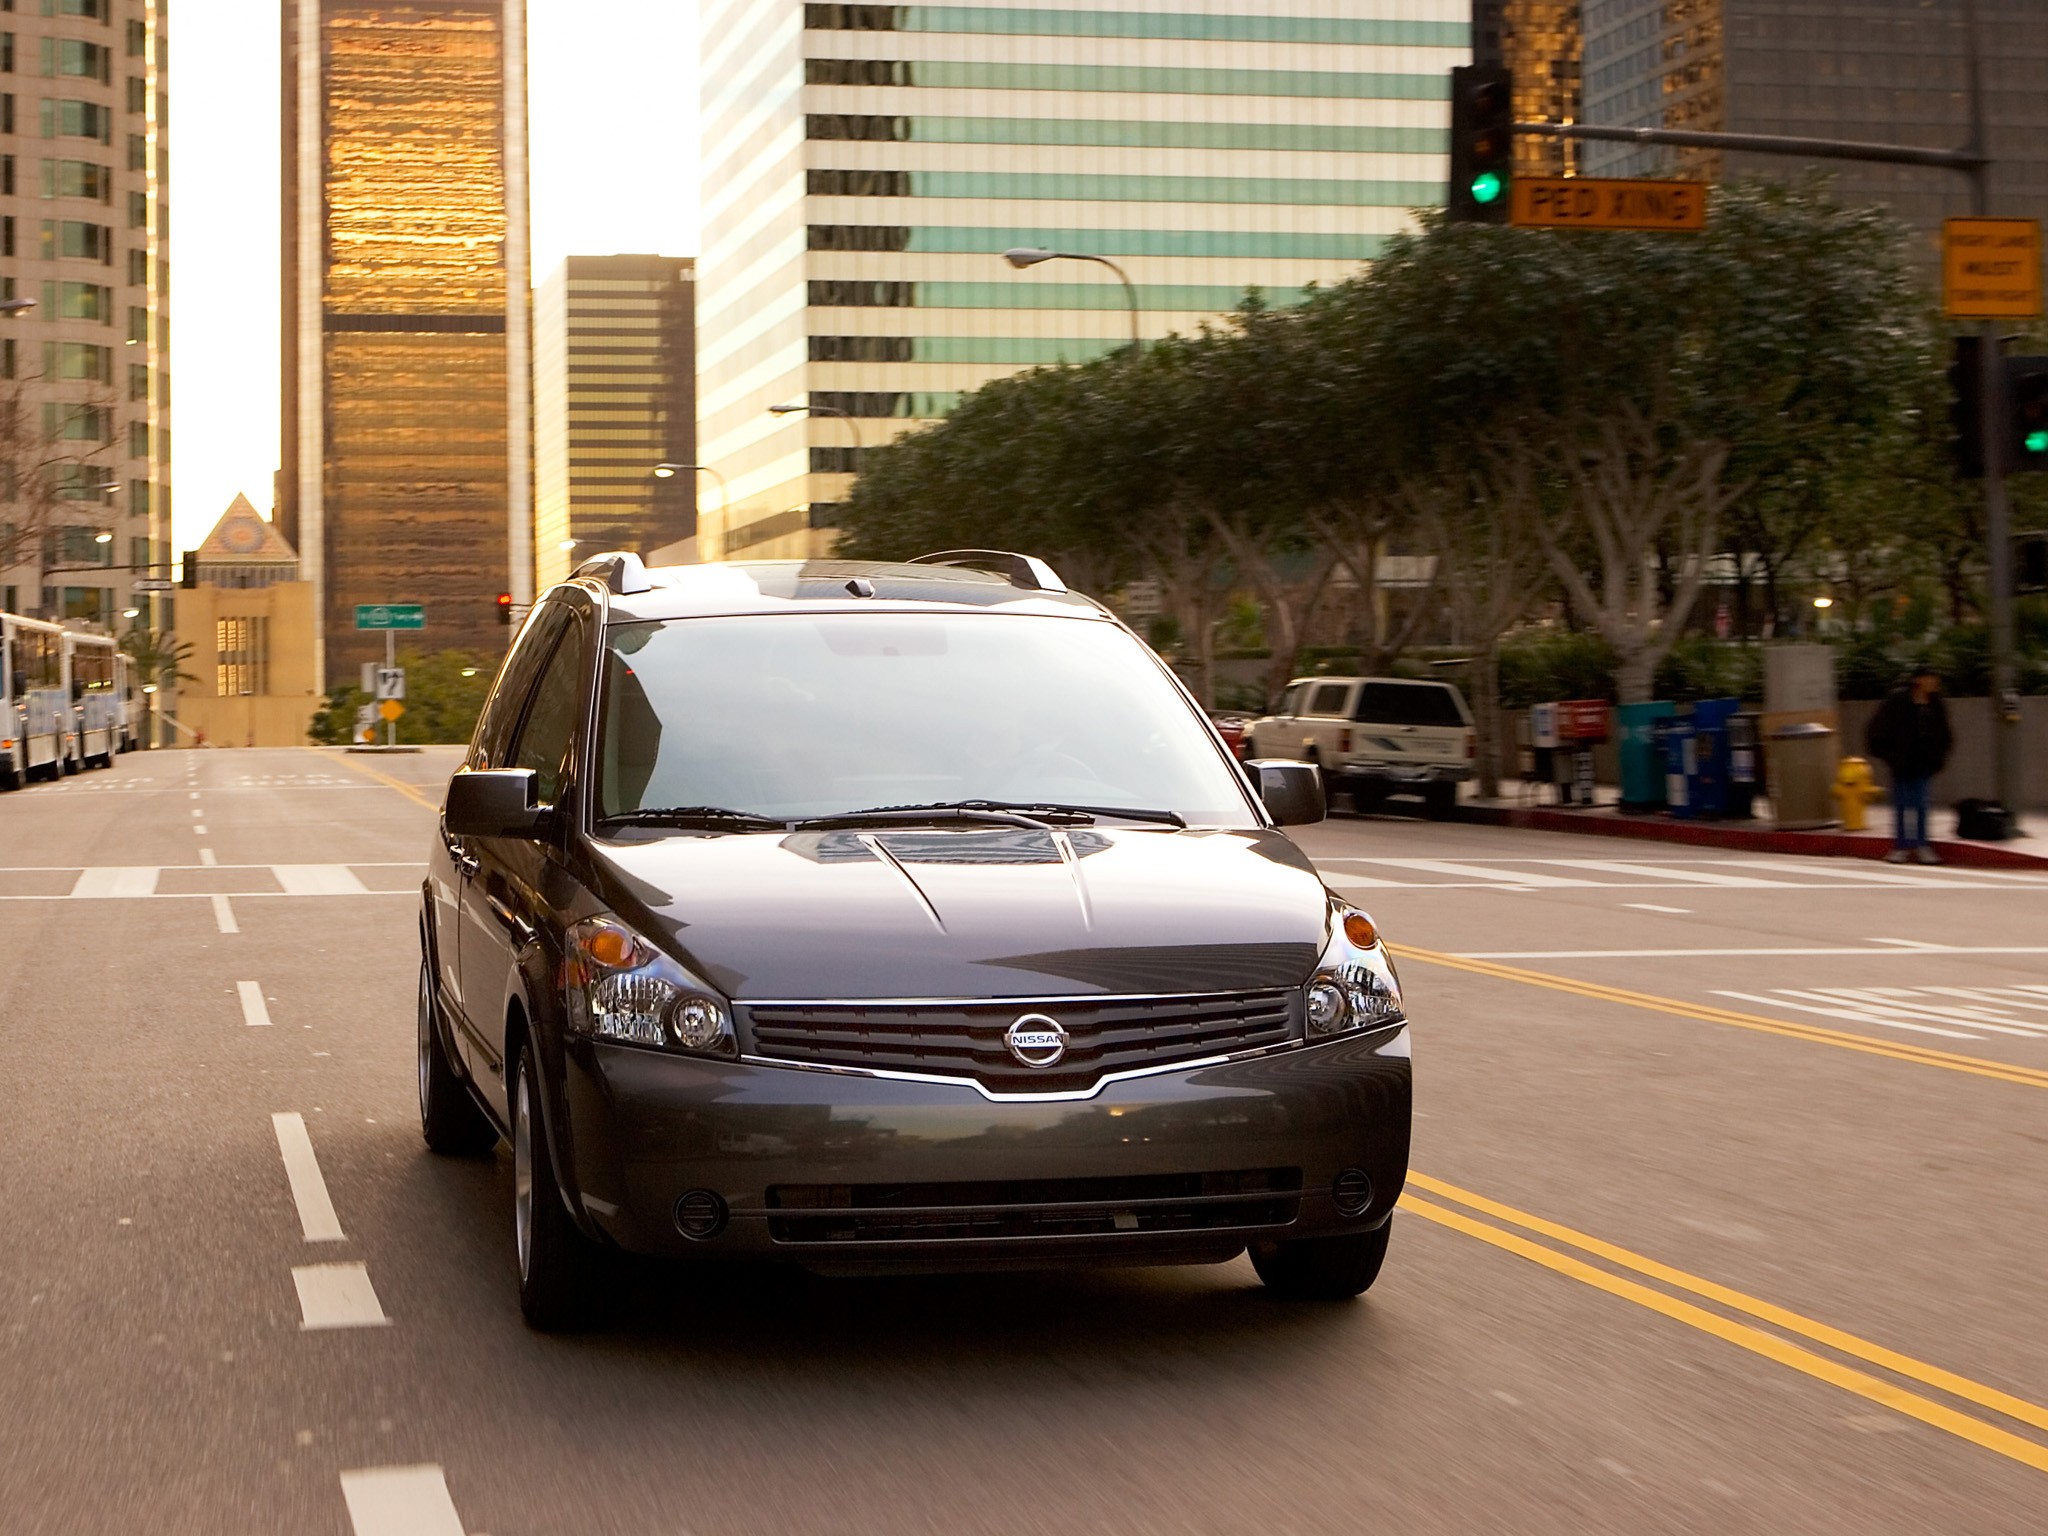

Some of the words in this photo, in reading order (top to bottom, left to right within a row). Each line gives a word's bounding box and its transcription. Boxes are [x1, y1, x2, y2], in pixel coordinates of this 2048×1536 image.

[1531, 187, 1596, 217] PED
[1609, 189, 1690, 220] XING
[1012, 1035, 1063, 1044] NISSAN
